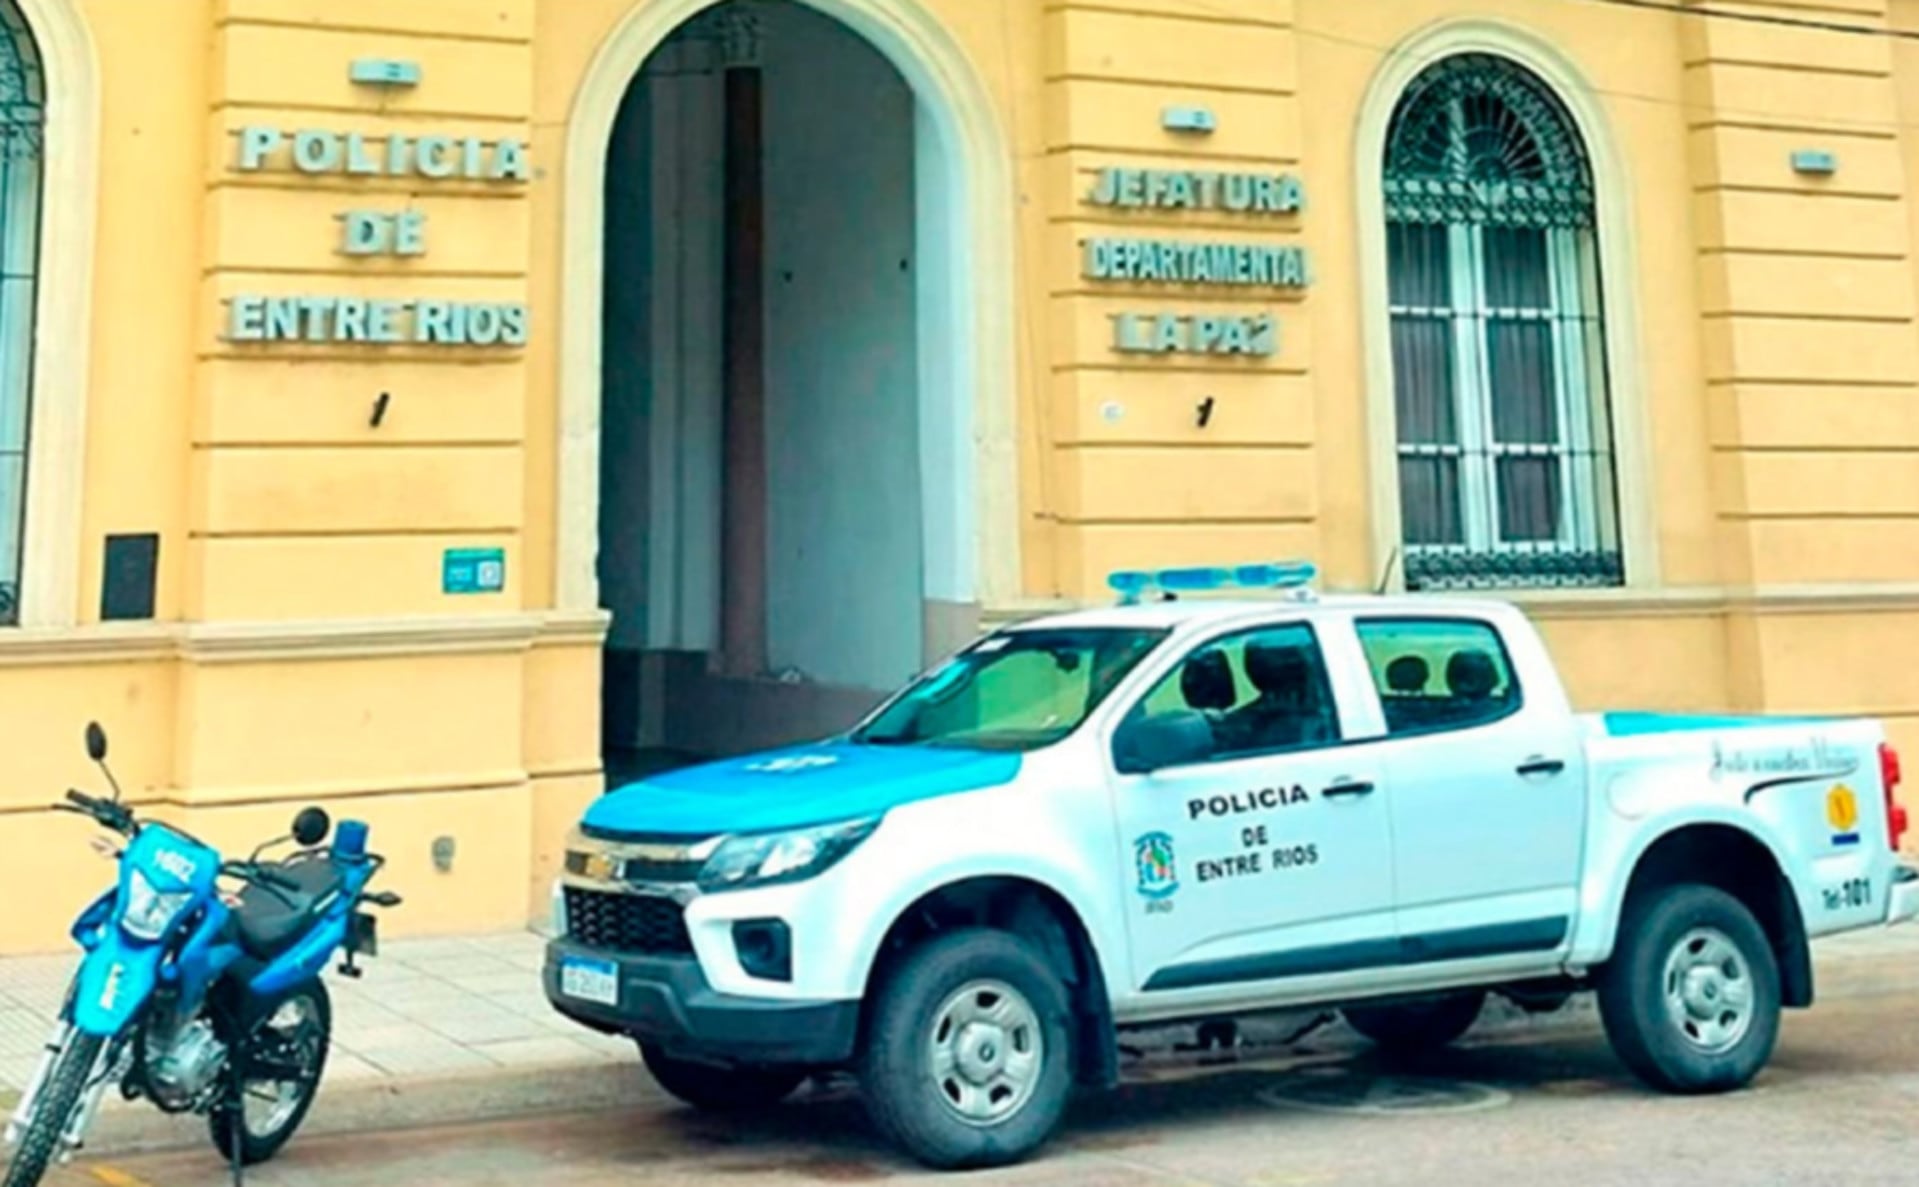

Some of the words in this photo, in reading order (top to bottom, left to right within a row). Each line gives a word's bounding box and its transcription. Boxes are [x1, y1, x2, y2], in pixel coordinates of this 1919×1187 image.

[239, 126, 529, 181] POLICIA
[1091, 167, 1306, 213] JEFATURA
[343, 210, 425, 255] DE
[231, 297, 401, 342] ENTRE
[412, 301, 528, 345] RIOS
[1114, 313, 1183, 353] LA
[1187, 783, 1310, 820] POLICIA
[1241, 825, 1269, 848] DE
[1195, 852, 1263, 882] ENTRE
[1272, 843, 1319, 869] RIOS
